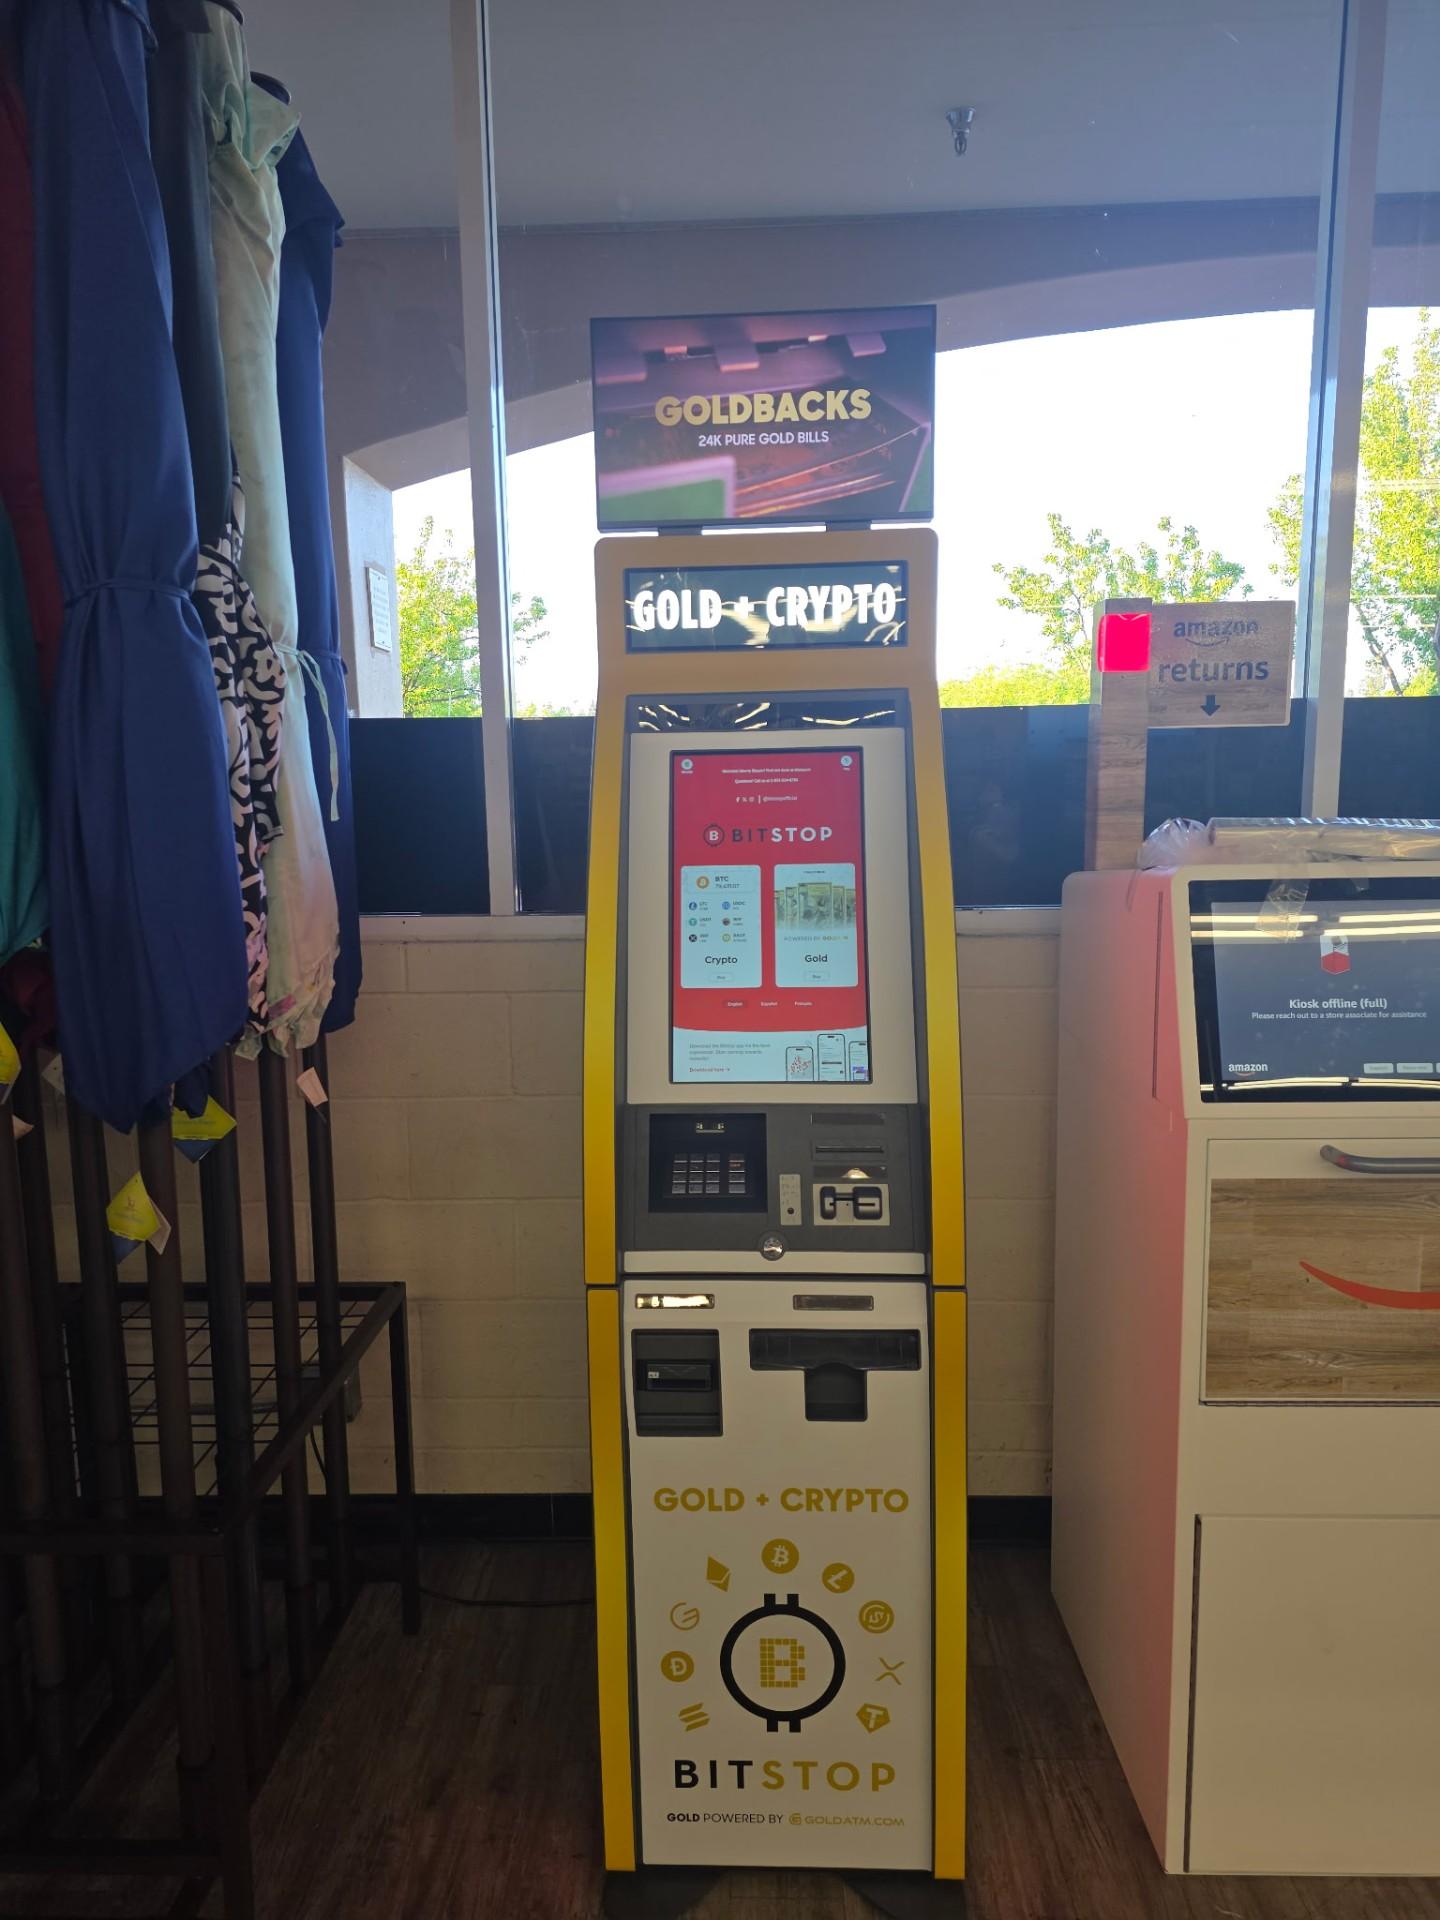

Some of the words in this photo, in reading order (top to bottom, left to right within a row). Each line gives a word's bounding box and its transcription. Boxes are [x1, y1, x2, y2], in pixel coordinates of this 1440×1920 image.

[655, 389, 872, 426] GOLDBACKS
[698, 435, 722, 447] 24K
[725, 433, 756, 446] PURE
[758, 431, 795, 445] GOLD
[797, 430, 829, 444] BILLS
[633, 589, 722, 631] GOLD
[766, 582, 897, 629] CRYPTO
[1173, 619, 1259, 638] amazon
[1158, 658, 1270, 682] returns
[732, 826, 833, 843] BITSTOP
[704, 955, 738, 966] Crypto
[804, 953, 828, 963] Gold
[1289, 998, 1319, 1009] Kiosk
[1322, 998, 1358, 1009] offline
[1360, 997, 1388, 1009] (full)
[1251, 1011, 1275, 1019] Please
[1275, 1011, 1296, 1019] reach
[1325, 1011, 1344, 1019] store
[1228, 1063, 1268, 1072] amazon
[653, 1487, 745, 1512] GOLD
[780, 1487, 909, 1513] CRYPTO
[673, 1759, 896, 1792] BITSTOP
[666, 1812, 701, 1823] GOLD
[703, 1813, 765, 1824] POWERED
[769, 1814, 784, 1824] BY
[804, 1815, 905, 1827] GOLDATM.COM
